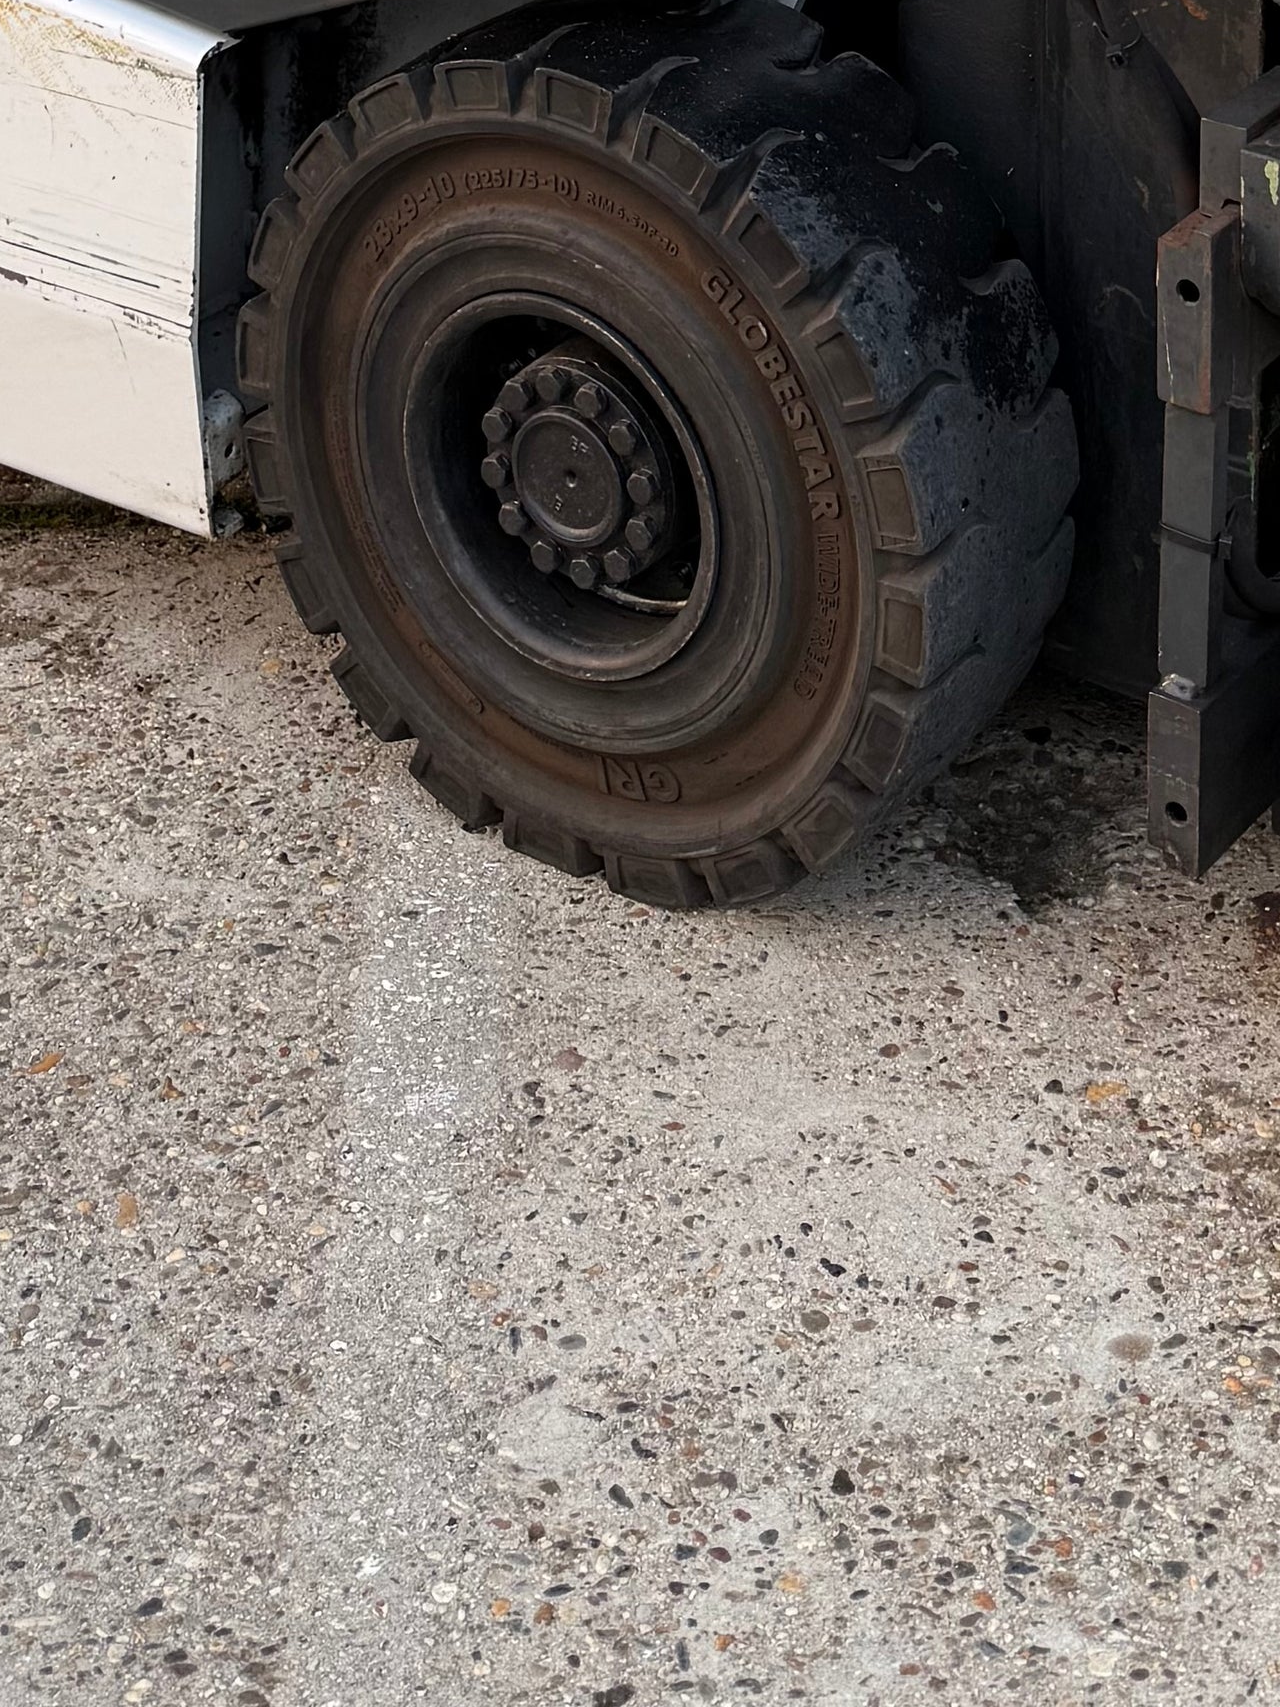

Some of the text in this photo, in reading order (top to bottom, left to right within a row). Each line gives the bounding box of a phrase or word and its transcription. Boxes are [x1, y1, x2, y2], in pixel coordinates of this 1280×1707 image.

[463, 167, 580, 201] (225/75-10)
[585, 190, 616, 215] RIM
[700, 265, 841, 522] GLOBESTAR
[596, 754, 683, 804] GRI
